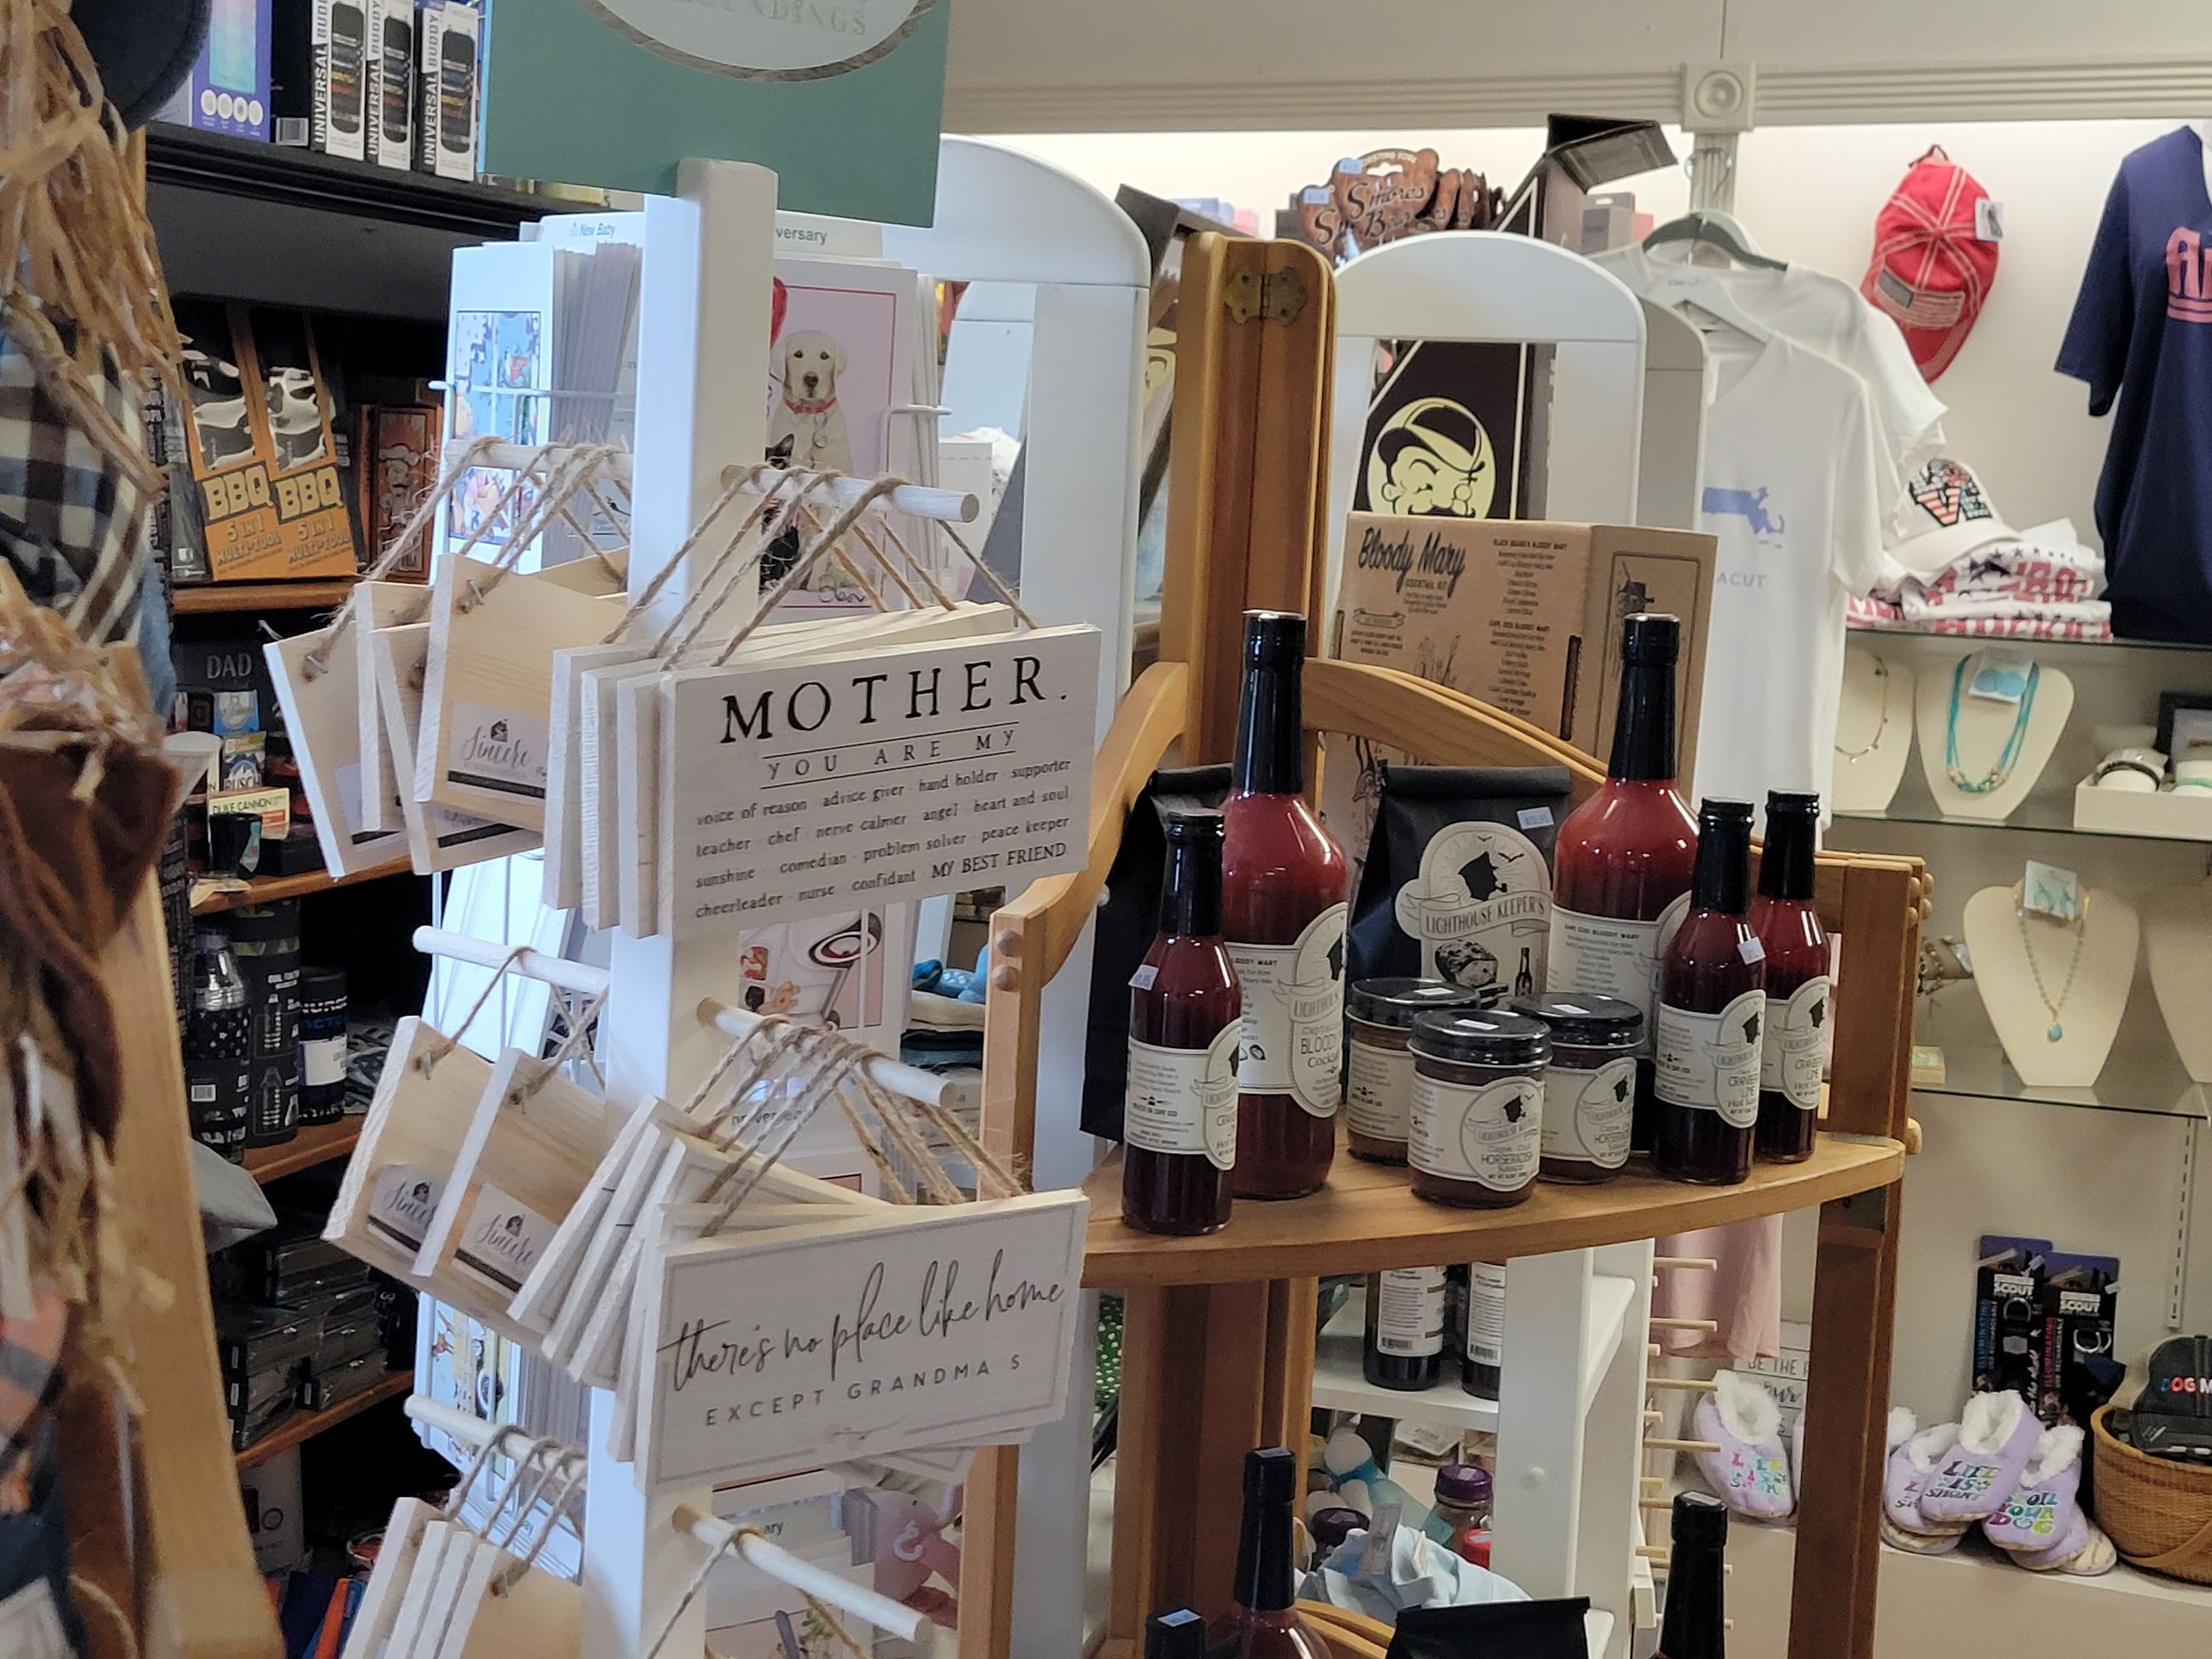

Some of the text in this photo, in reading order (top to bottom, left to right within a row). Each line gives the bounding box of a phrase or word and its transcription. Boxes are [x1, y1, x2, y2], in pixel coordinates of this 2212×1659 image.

[314, 45, 328, 144] UNIVERSAL
[368, 61, 380, 156] UNIVERSAL
[424, 14, 439, 165] UNIVERSAL BUDDY
[775, 227, 828, 245] versary
[202, 465, 274, 521] BBQ
[275, 465, 345, 521] BBQ
[218, 530, 282, 566] MULTI-TOOL
[227, 520, 237, 542] 5
[288, 530, 351, 565] MULTI-TOOL
[299, 519, 309, 541] 5
[1358, 527, 1414, 594] Bloody
[1417, 531, 1467, 599] Mary
[1717, 572, 1766, 588] ACUT
[206, 653, 253, 679] DAD
[768, 729, 1014, 780] YOU ARE MY
[213, 797, 272, 814] DUKE CANNON
[697, 760, 1071, 825] voice of reason advice giver hand holder supporter
[696, 785, 1069, 858] teacher chef nerve calmer angel heart and soul
[696, 818, 1069, 888] sunshine comedian problem solver peace keeper
[695, 842, 1067, 918] cheerleader nurse confidant MY BEST FRIEND
[1426, 910, 1492, 935] LIGHTHOUSE
[1993, 1282, 2034, 1296] SCOUT
[2061, 1300, 2101, 1313] SCOUT
[784, 1327, 823, 1359] no
[831, 1262, 915, 1381] place
[919, 1260, 981, 1337] like
[984, 1248, 1065, 1322] home
[1774, 1360, 1799, 1376] THE
[705, 1388, 825, 1427] EXCEPT
